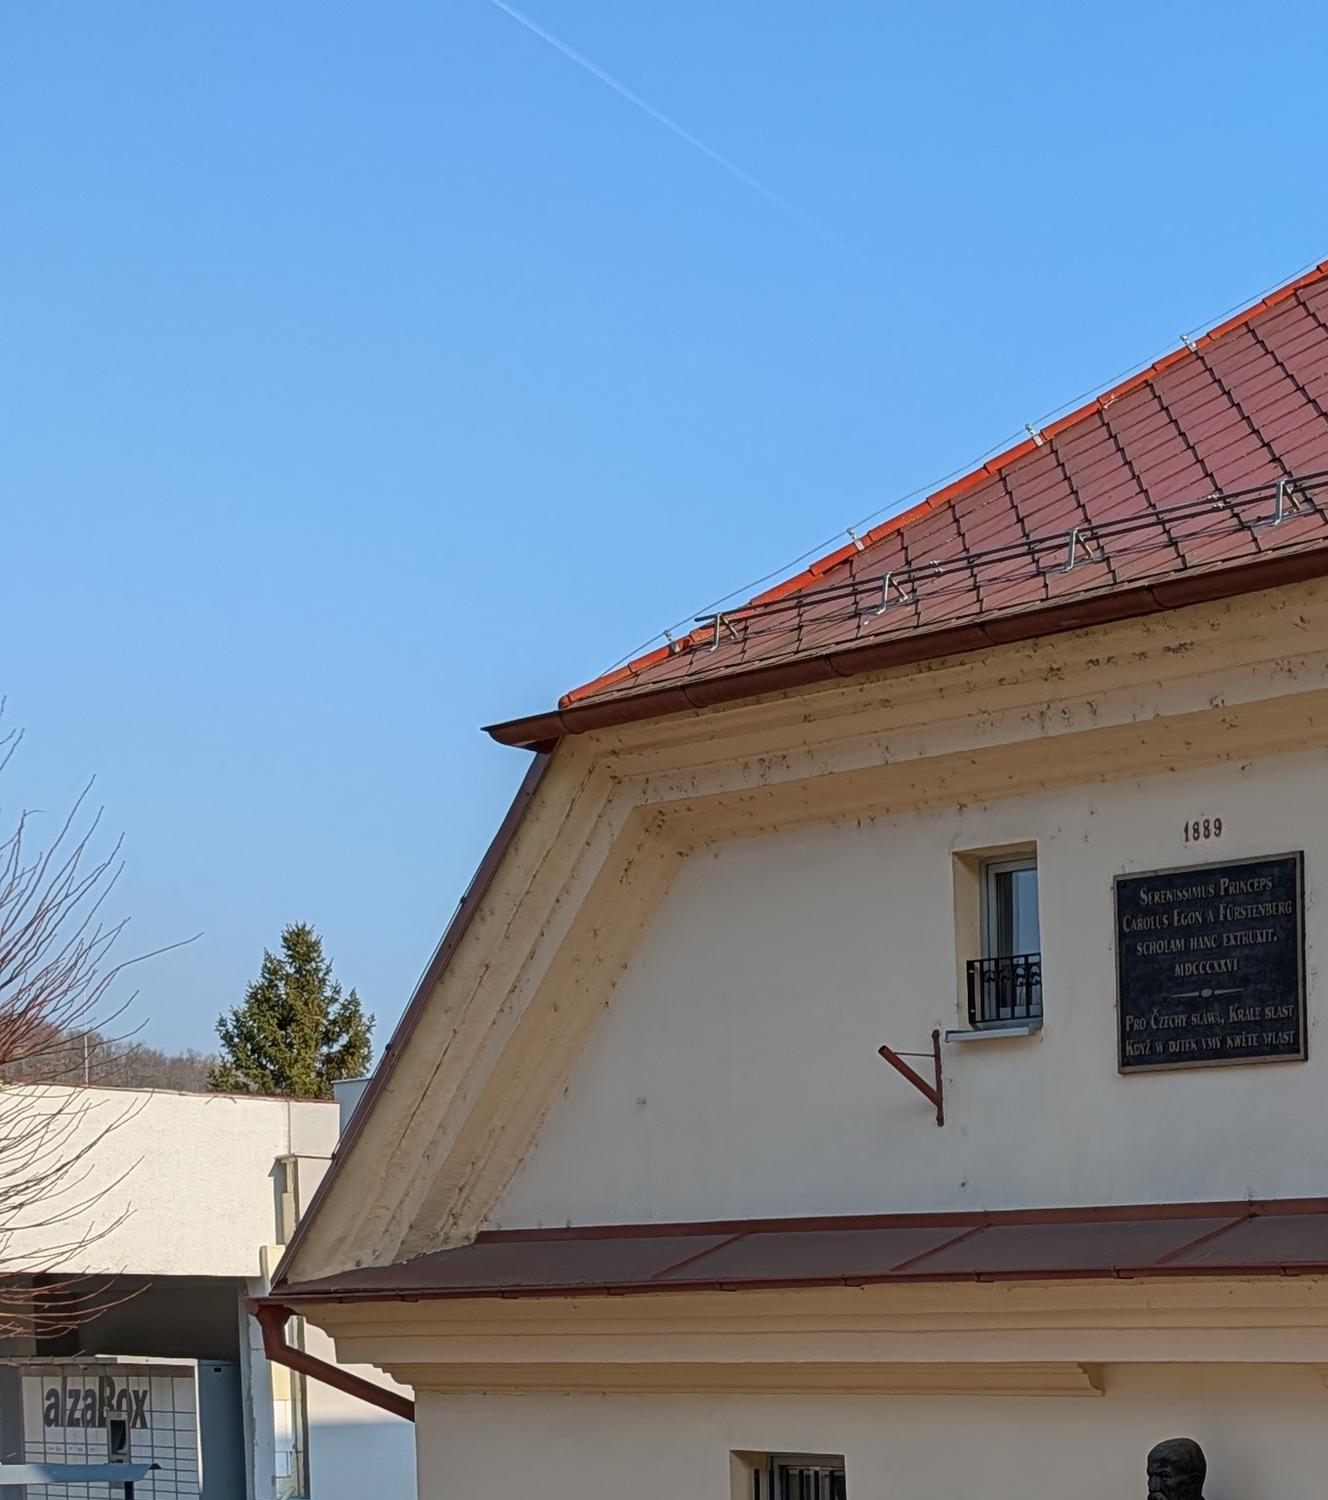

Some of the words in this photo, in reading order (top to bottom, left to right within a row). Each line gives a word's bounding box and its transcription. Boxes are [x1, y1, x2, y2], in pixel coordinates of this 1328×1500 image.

[1184, 817, 1223, 842] 1889
[1219, 877, 1273, 896] PRINCEPS
[1122, 914, 1168, 933] CAROLUS
[1173, 909, 1203, 926] EGON
[1136, 938, 1185, 956] SCHOLAM
[1190, 934, 1218, 950] HANC
[1223, 929, 1278, 947] EXTRUXIT.
[1174, 958, 1238, 976] MDCCCXXVI
[1126, 1015, 1146, 1031] PRO
[44, 1375, 150, 1429] alzaBox
